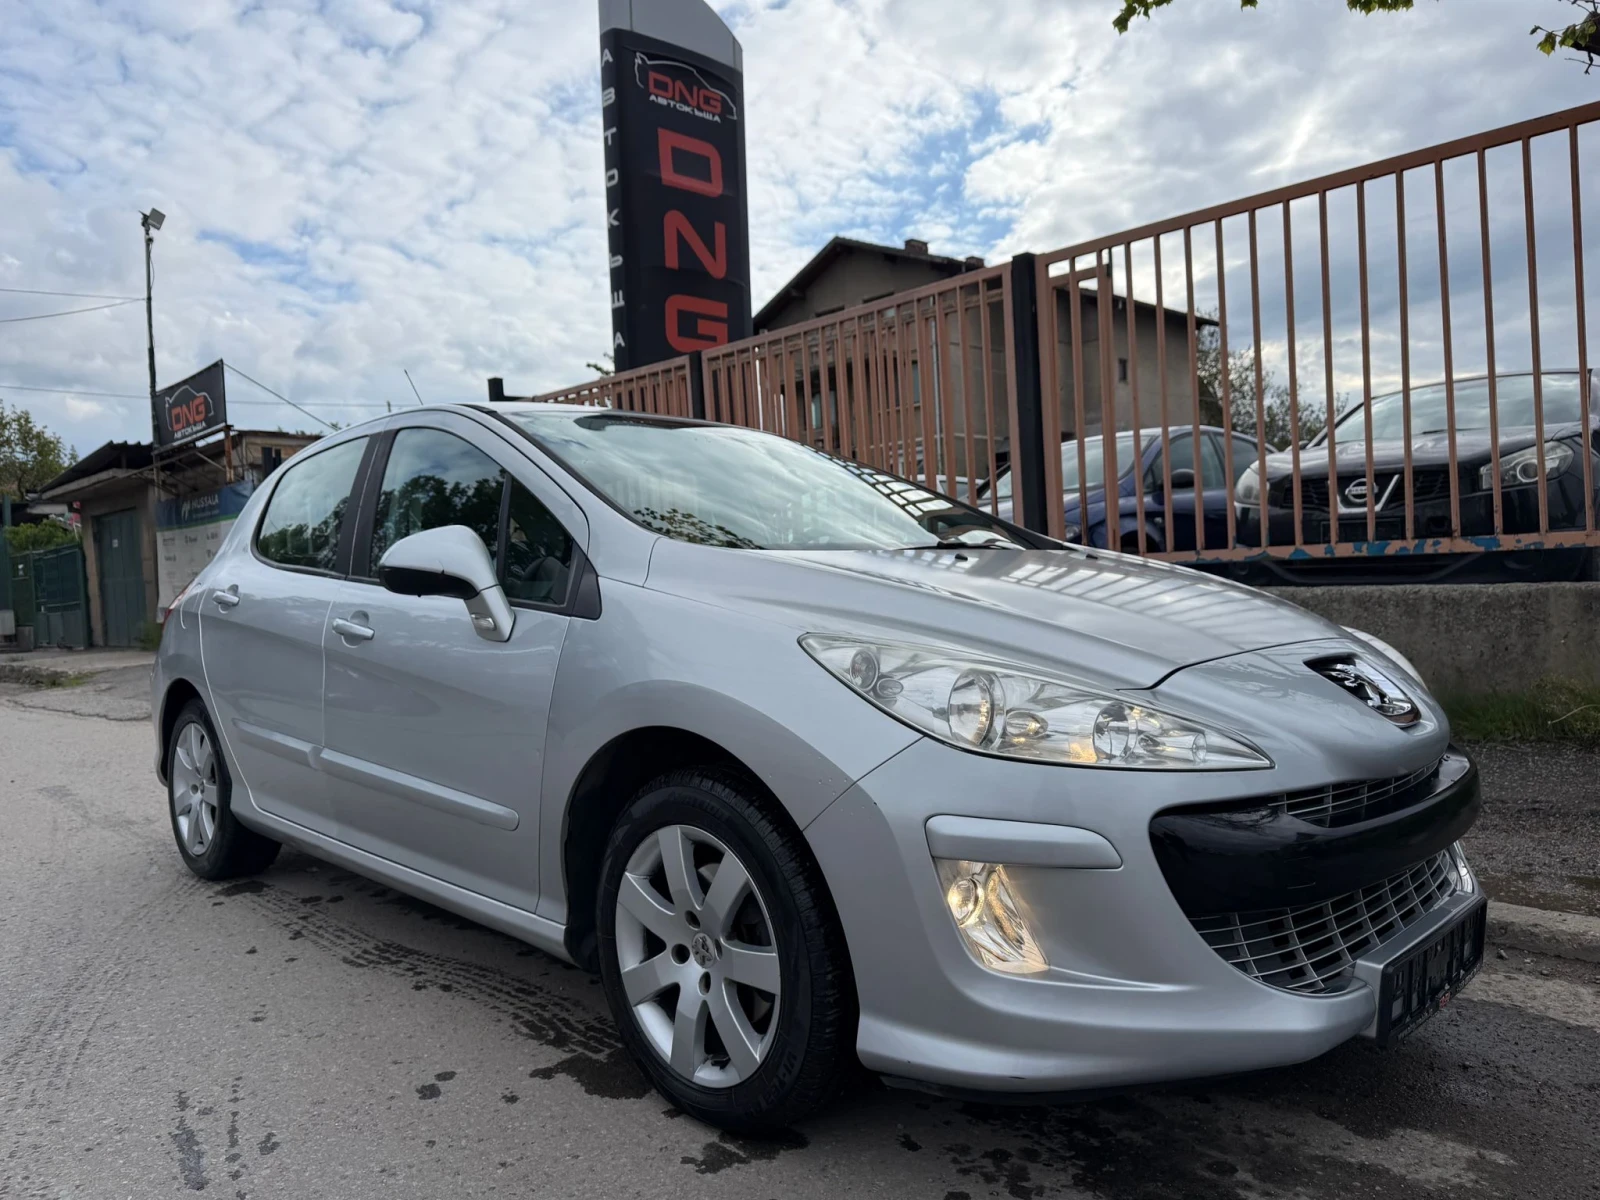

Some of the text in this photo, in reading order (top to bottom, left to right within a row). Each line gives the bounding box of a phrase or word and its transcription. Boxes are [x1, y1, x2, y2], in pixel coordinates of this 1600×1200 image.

[649, 70, 722, 115] DNG
[649, 94, 722, 123] АВТОКЪША
[657, 127, 728, 353] DNG
[171, 394, 206, 432] DNG
